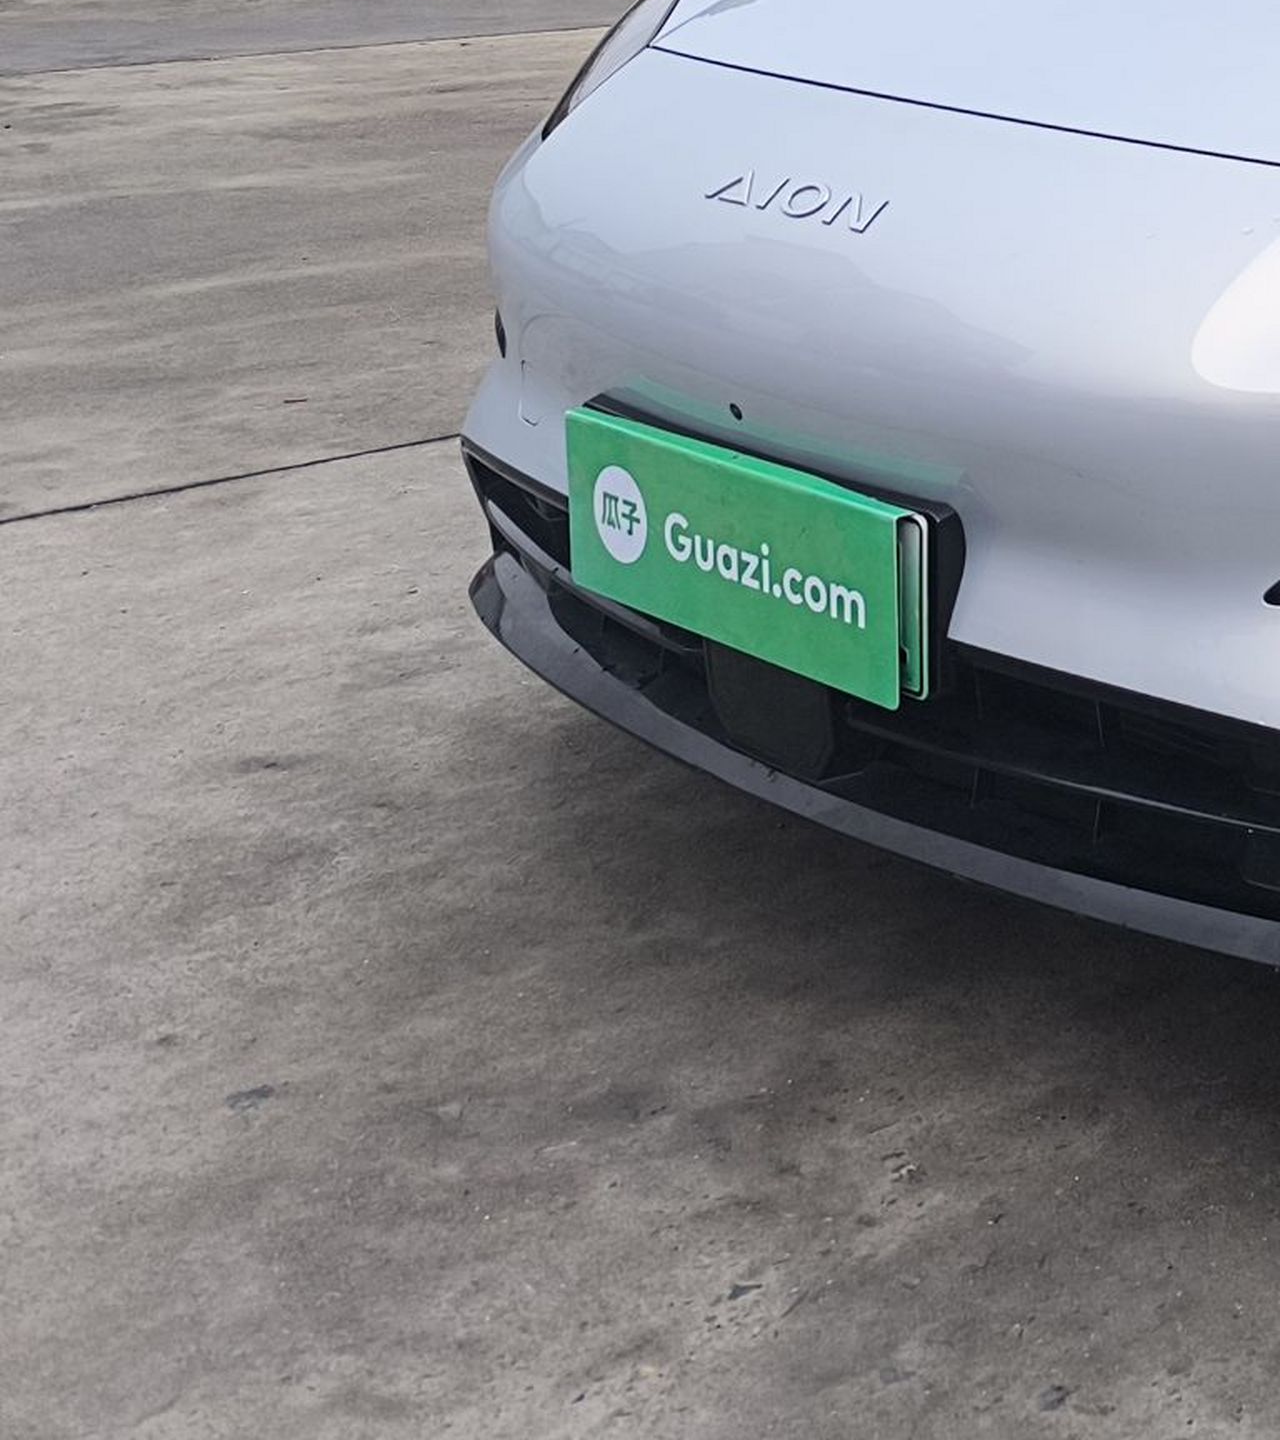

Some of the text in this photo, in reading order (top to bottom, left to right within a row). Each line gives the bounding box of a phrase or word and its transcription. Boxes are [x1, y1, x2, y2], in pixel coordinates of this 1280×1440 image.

[705, 168, 890, 234] AION
[602, 491, 641, 536] 瓜子
[664, 512, 866, 629] Guazi.com
